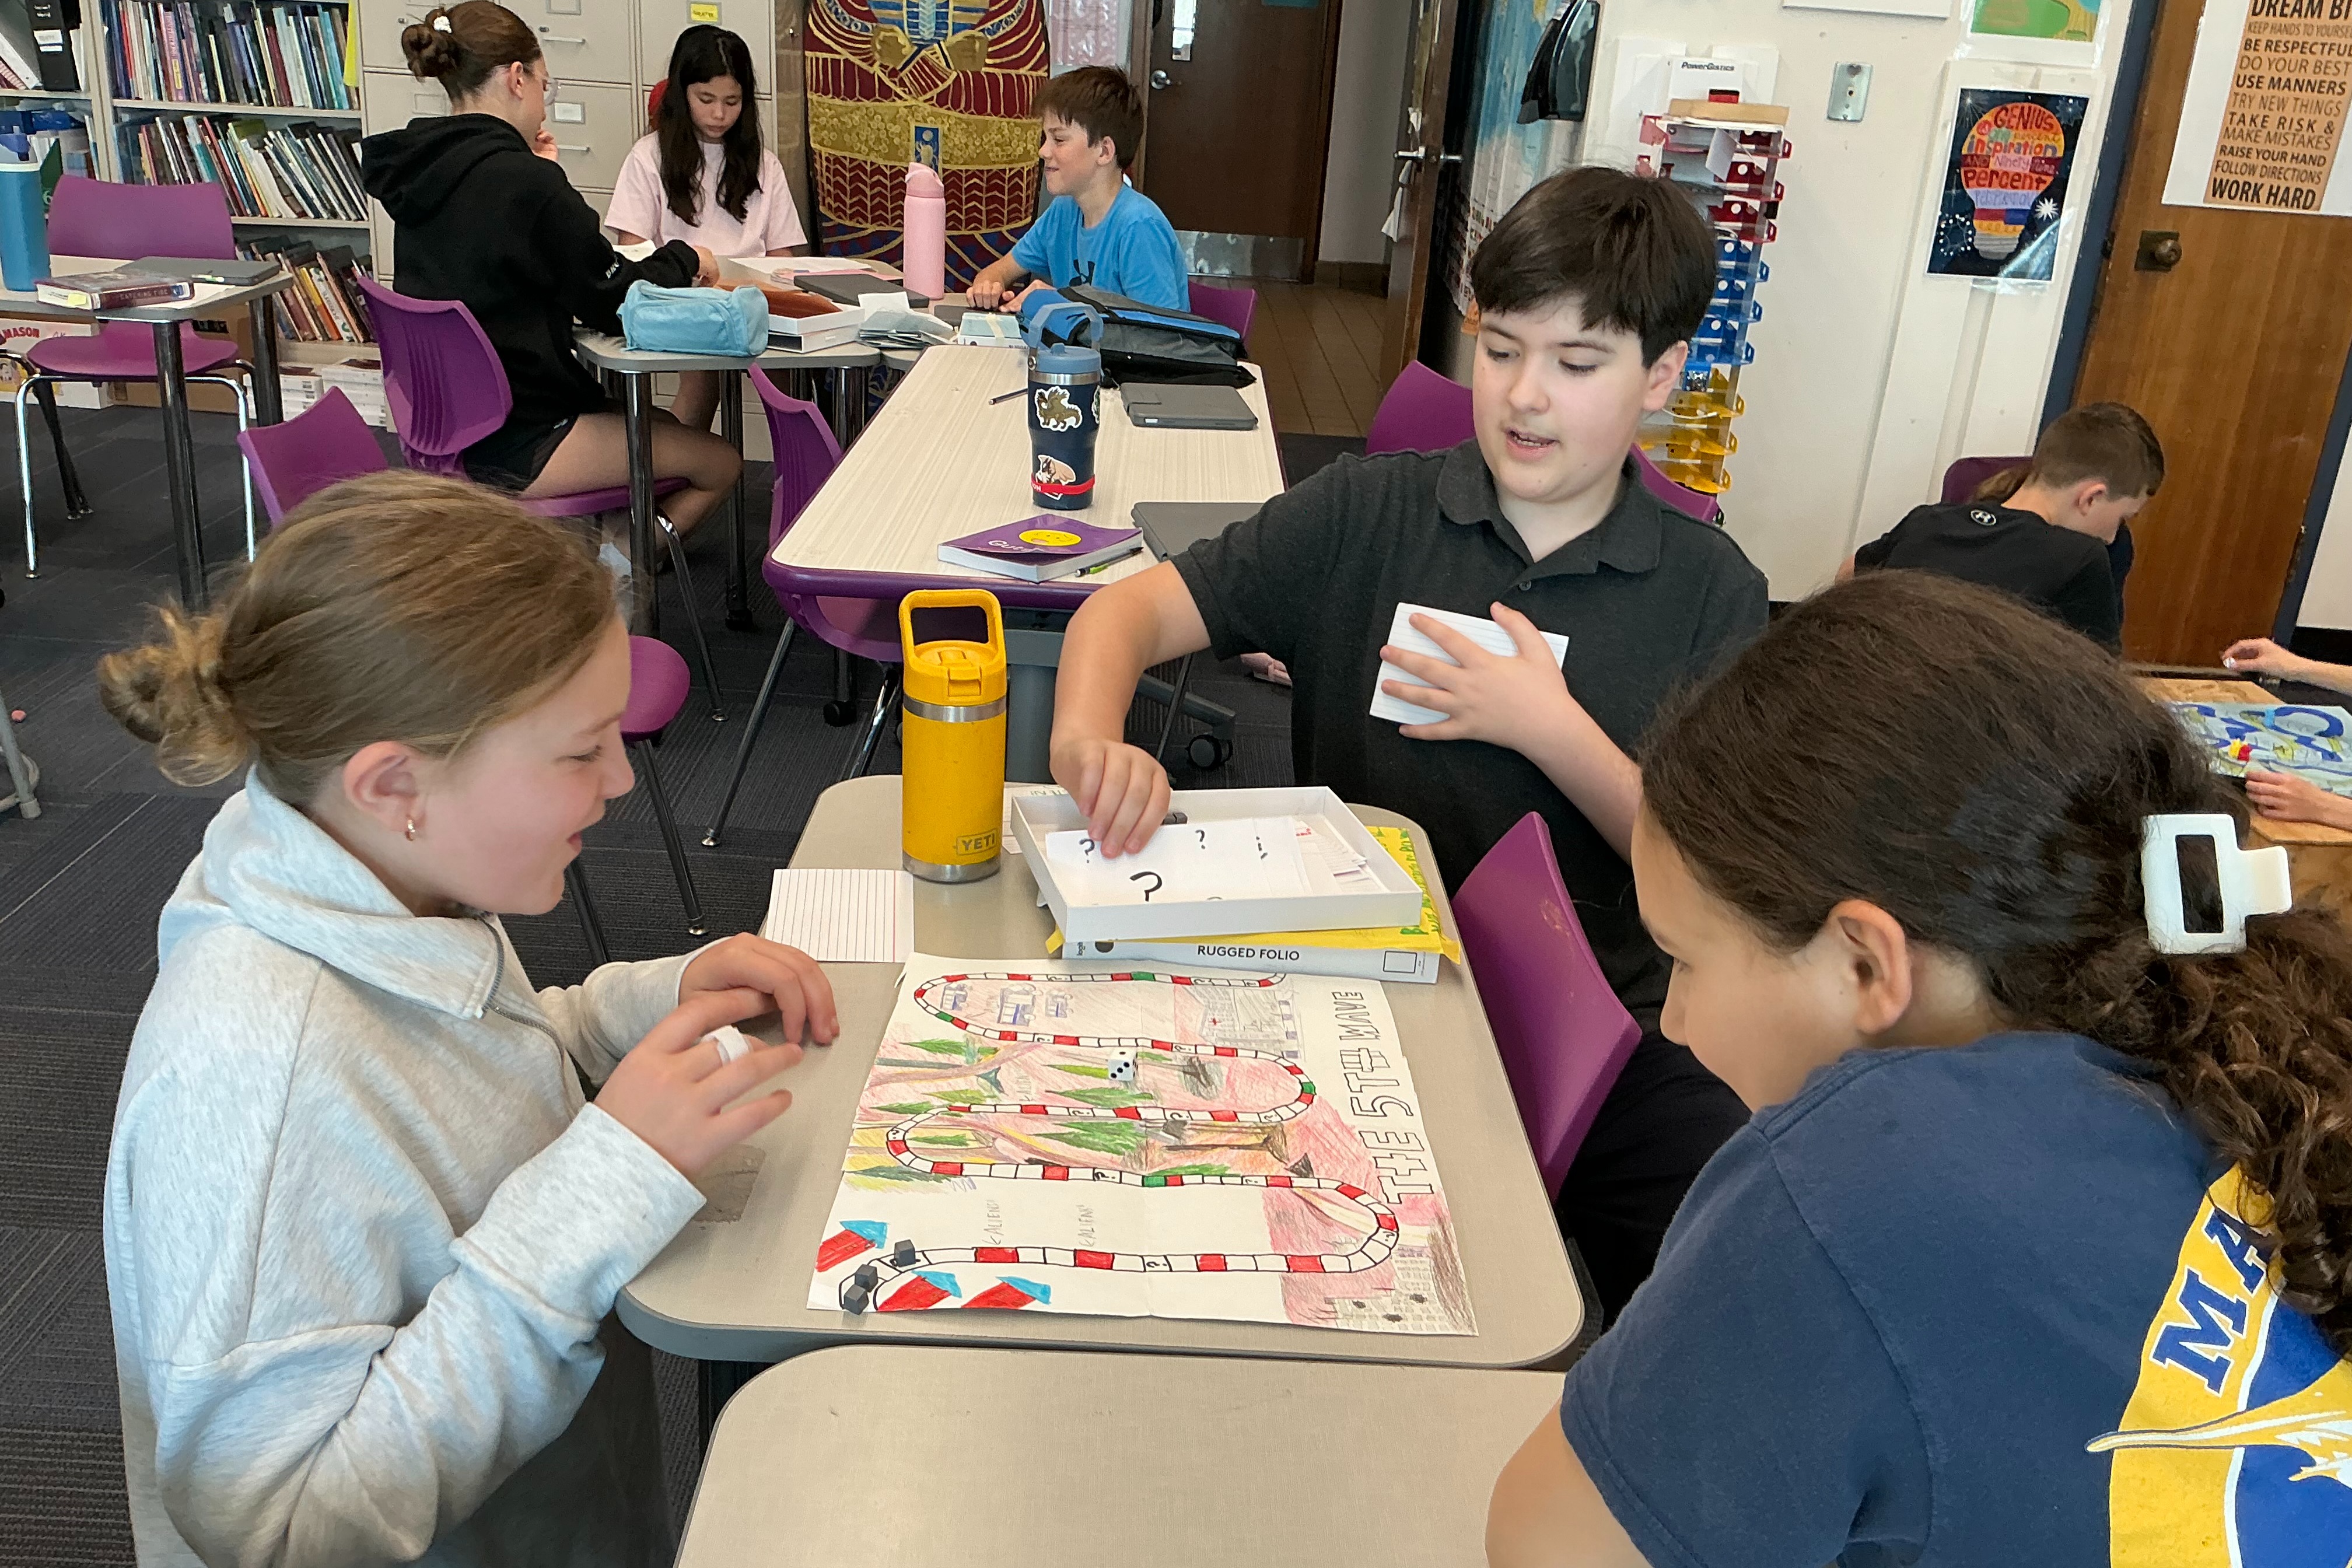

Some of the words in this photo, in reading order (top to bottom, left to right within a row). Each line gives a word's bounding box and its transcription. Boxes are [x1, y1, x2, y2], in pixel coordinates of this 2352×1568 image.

[2251, 0, 2323, 19] DREAM
[2248, 21, 2269, 35] KEEP
[2270, 22, 2301, 36] HANDS
[2302, 24, 2315, 36] TO
[2244, 37, 2262, 52] BE
[2239, 55, 2262, 71] DO
[2267, 57, 2309, 74] YOUR
[2313, 60, 2352, 76] BEST
[2236, 74, 2265, 89] USE
[2267, 76, 2347, 96] MANNERS
[2232, 92, 2256, 110] TRY
[2259, 95, 2289, 113] NEW
[2292, 96, 2343, 117] THINGS
[1994, 106, 2054, 131] GENIUS
[2228, 111, 2270, 130] TAKE
[2277, 116, 2317, 134] RISK
[2323, 120, 2335, 135] &
[2223, 127, 2262, 144] MAKE
[2264, 131, 2333, 152] MISTAKES
[2219, 144, 2253, 159] RAISE
[2255, 148, 2288, 163] YOUR
[2290, 152, 2327, 167] HAND
[2215, 159, 2258, 177] FOLLOW
[2259, 164, 2323, 185] DIRECTIONS
[2212, 177, 2264, 204] WORK
[2265, 184, 2316, 210] HARD
[2, 327, 40, 338] MASON
[962, 833, 995, 852] YETI
[1198, 945, 1256, 958] RUGGED
[1259, 949, 1300, 961] FOLIO
[1331, 991, 1381, 1041] WAVE
[1339, 1048, 1414, 1117] 5TH
[1359, 1130, 1434, 1204] THE
